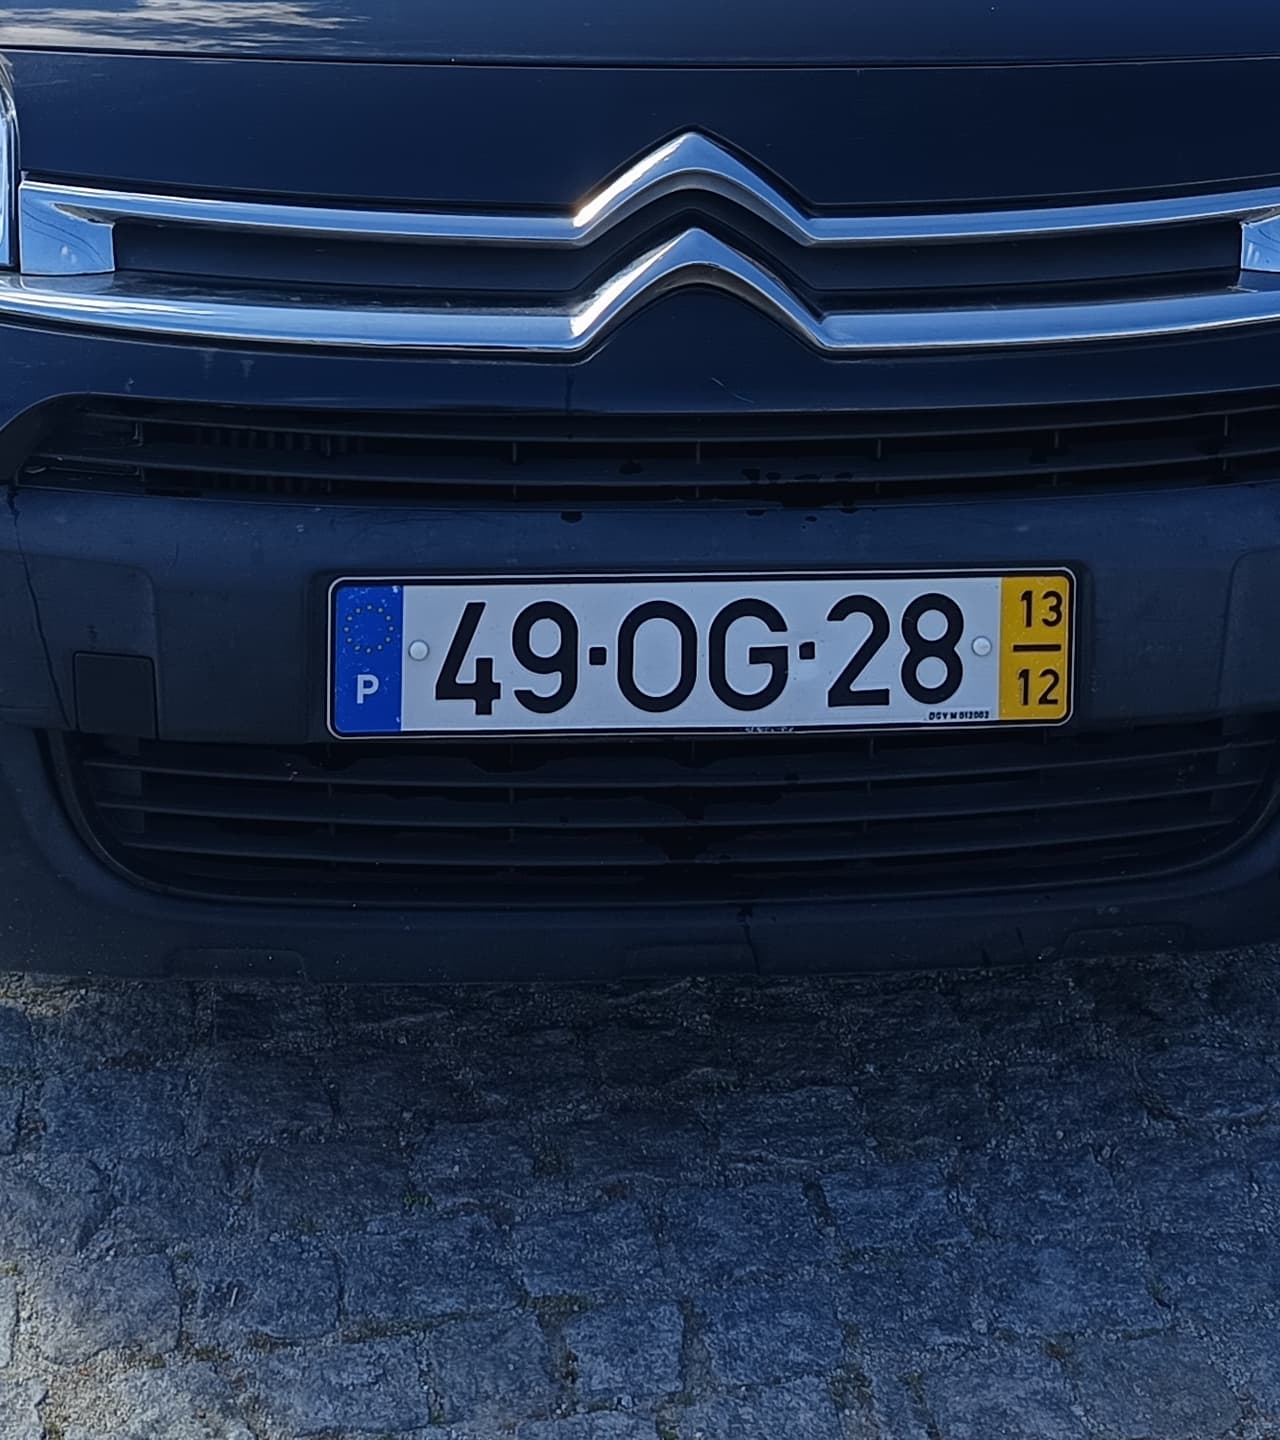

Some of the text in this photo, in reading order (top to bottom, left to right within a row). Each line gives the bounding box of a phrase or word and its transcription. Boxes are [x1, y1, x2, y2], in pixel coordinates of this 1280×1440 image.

[1019, 589, 1064, 628] 13
[355, 673, 380, 705] P
[1018, 668, 1061, 706] 12
